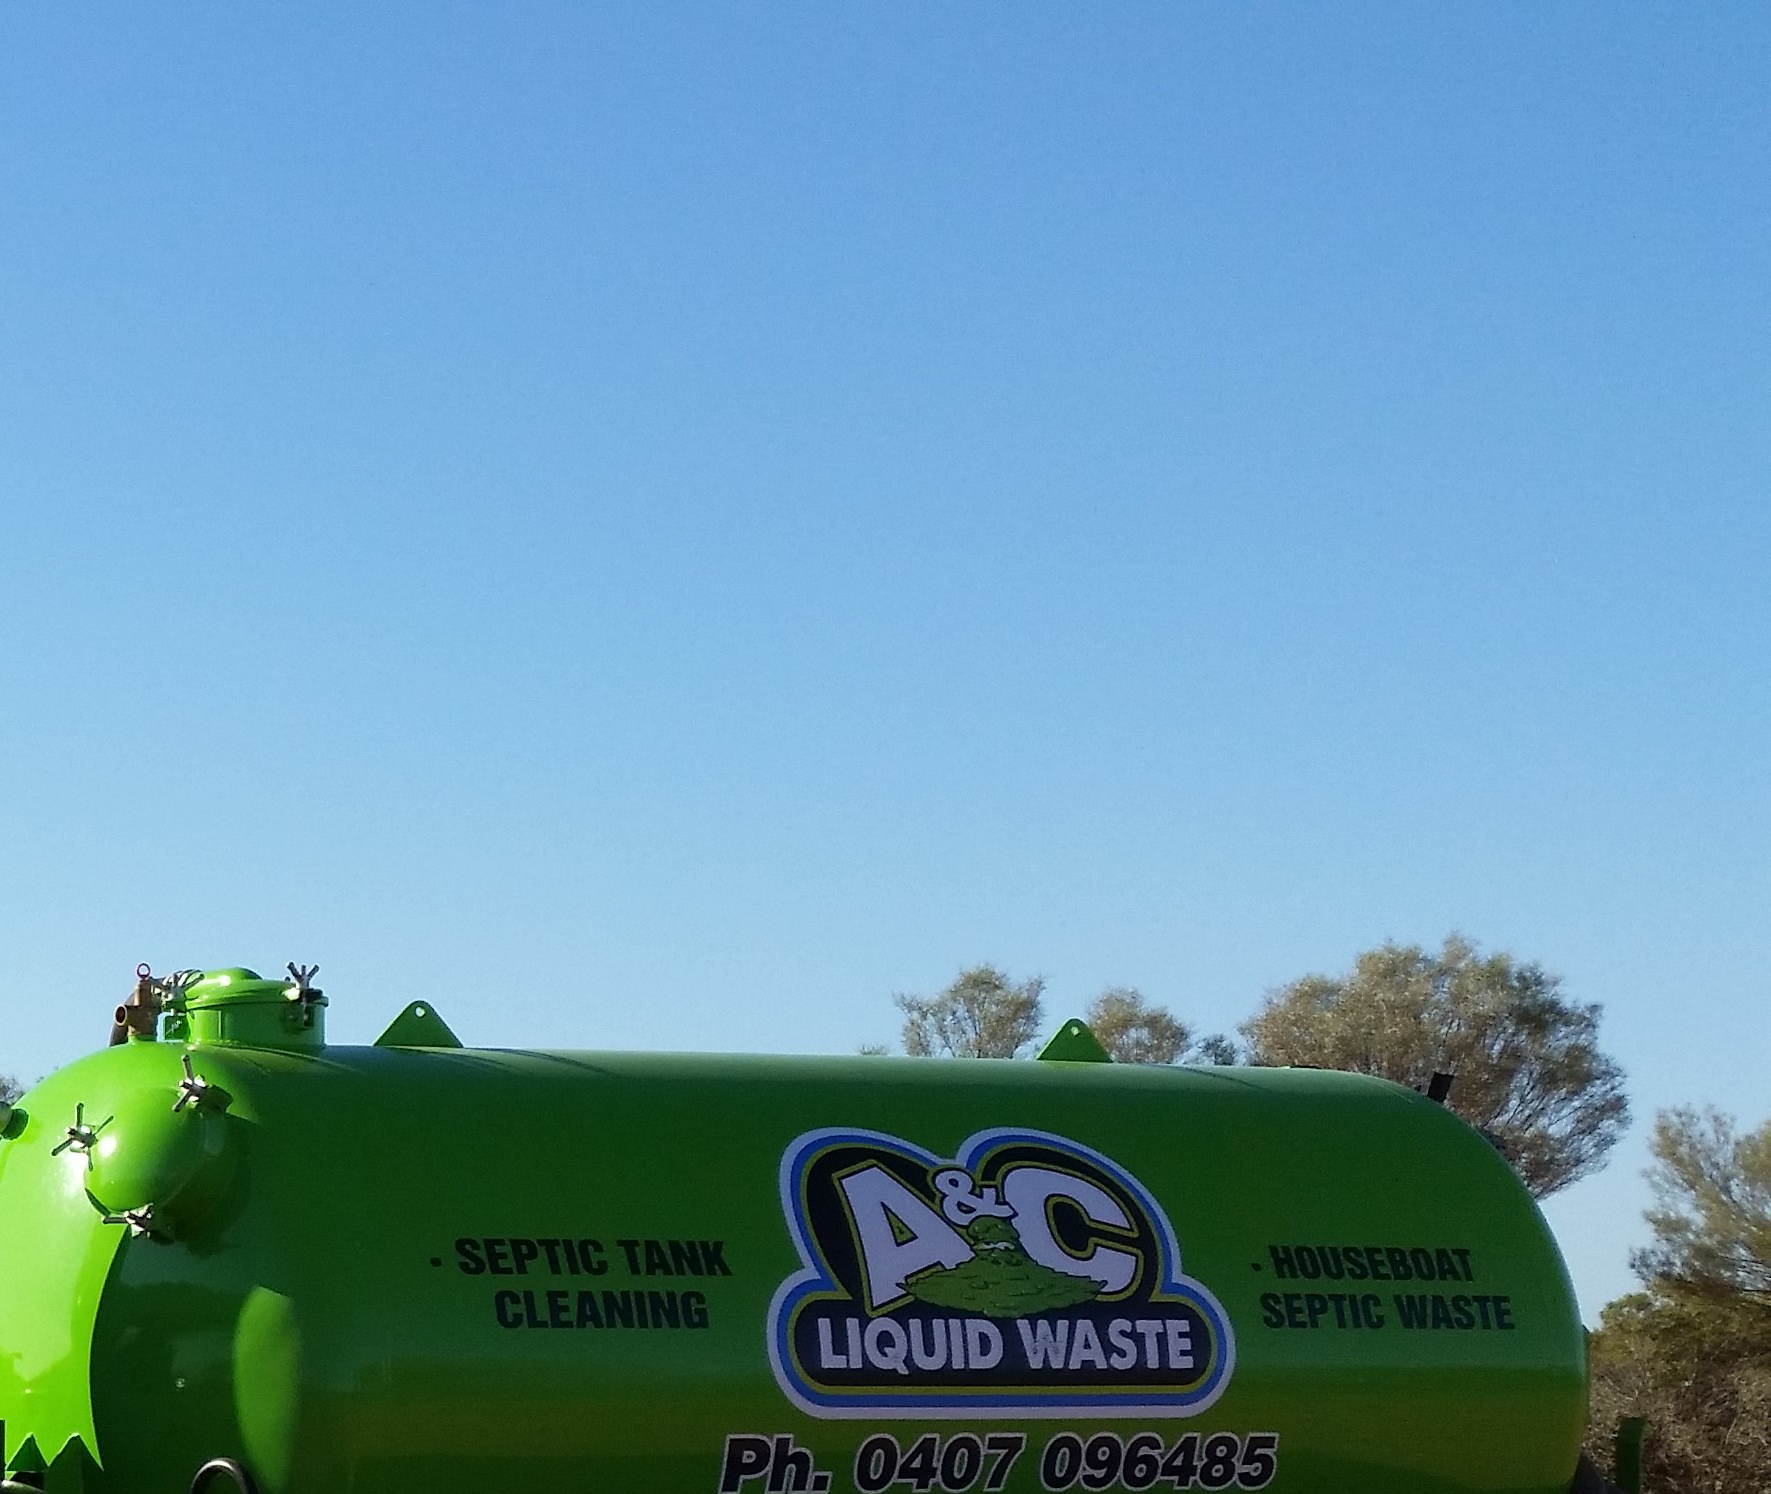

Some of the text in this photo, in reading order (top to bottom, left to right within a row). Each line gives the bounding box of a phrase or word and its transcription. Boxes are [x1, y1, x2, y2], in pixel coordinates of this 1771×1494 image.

[835, 1162, 1142, 1312] A&C
[454, 1238, 733, 1277] SEPTIC TANK
[1268, 1245, 1475, 1282] HOUSEBOAT
[494, 1290, 710, 1329] CLEANING
[1260, 1292, 1516, 1330] SEPTIC WASTE
[817, 1318, 1194, 1375] LIQUID WASTE
[854, 1433, 1026, 1493] 0407
[1041, 1432, 1279, 1492] 096485
